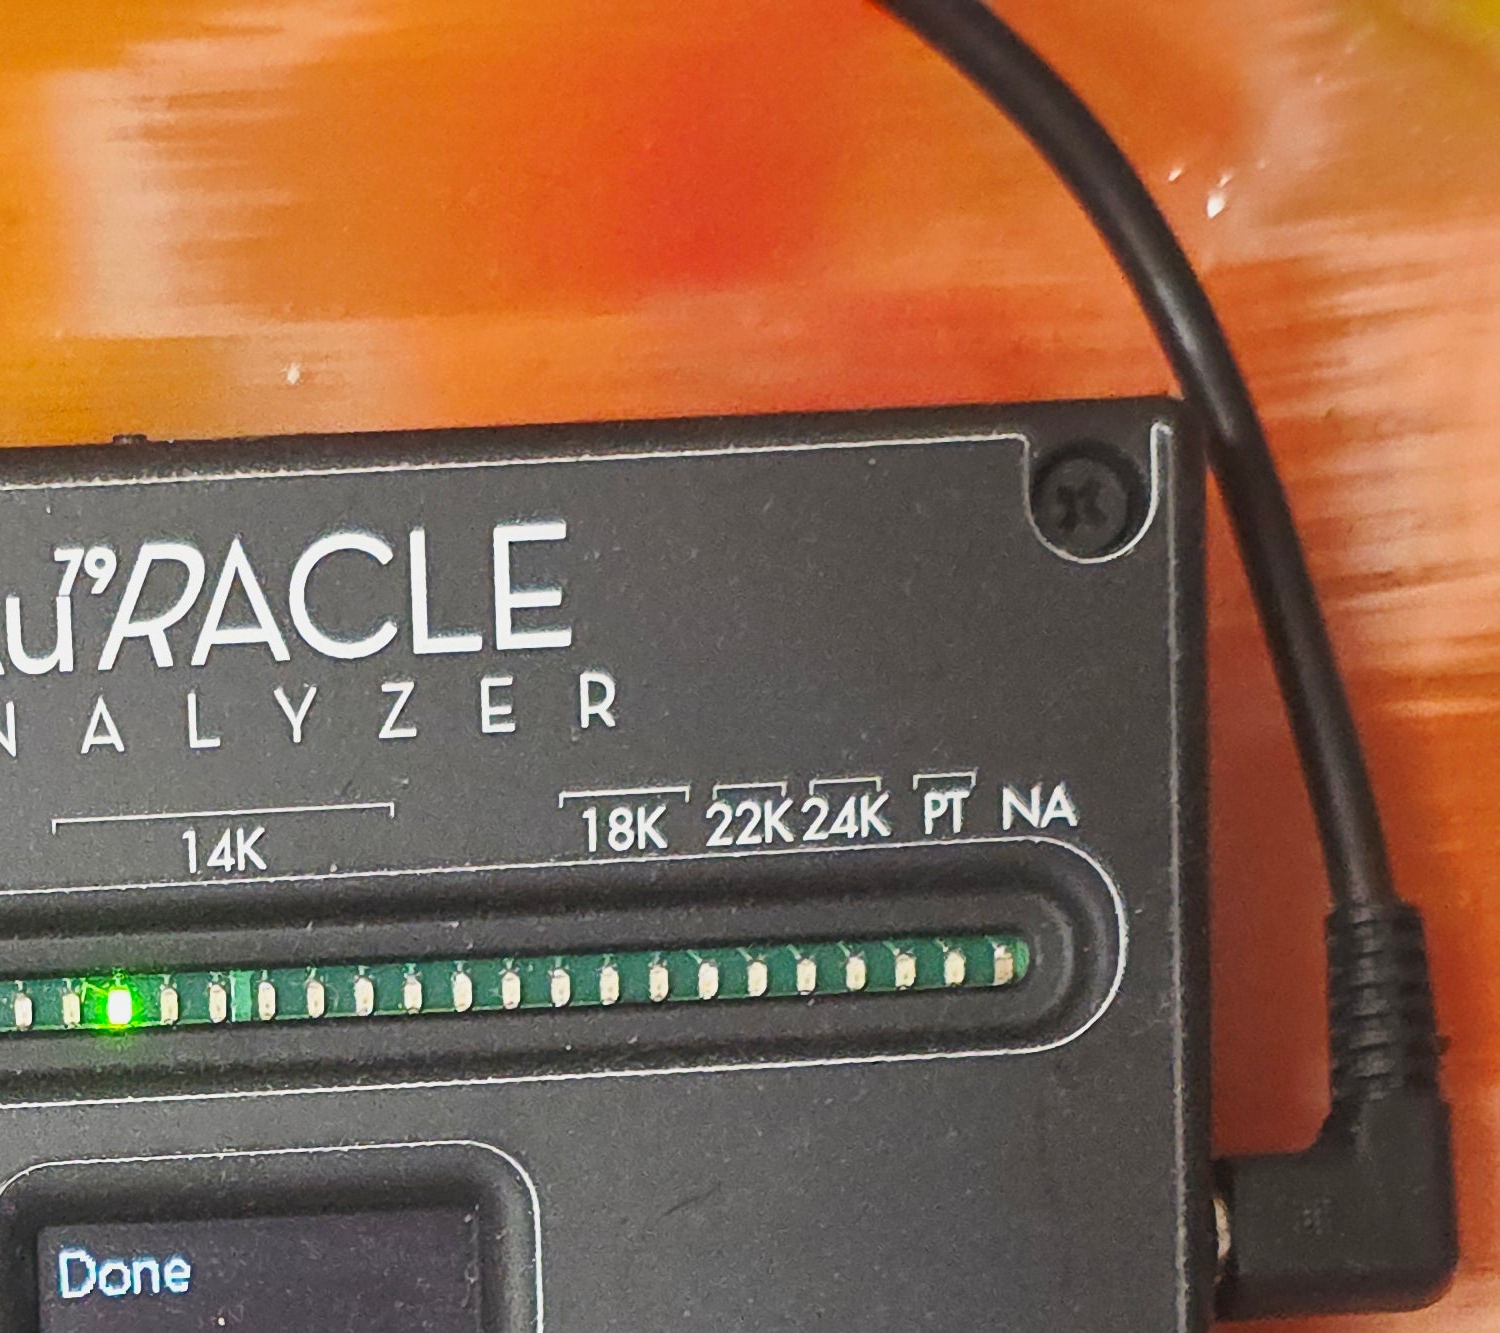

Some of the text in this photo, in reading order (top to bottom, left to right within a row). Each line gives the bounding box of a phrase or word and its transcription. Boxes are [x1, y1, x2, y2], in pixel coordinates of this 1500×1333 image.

[181, 825, 268, 874] 14K
[582, 803, 668, 853] 18K
[705, 799, 795, 847] 22K
[800, 793, 891, 842] 24K
[923, 789, 970, 836] PT
[1002, 782, 1078, 831] NA
[58, 1248, 192, 1299] Done
